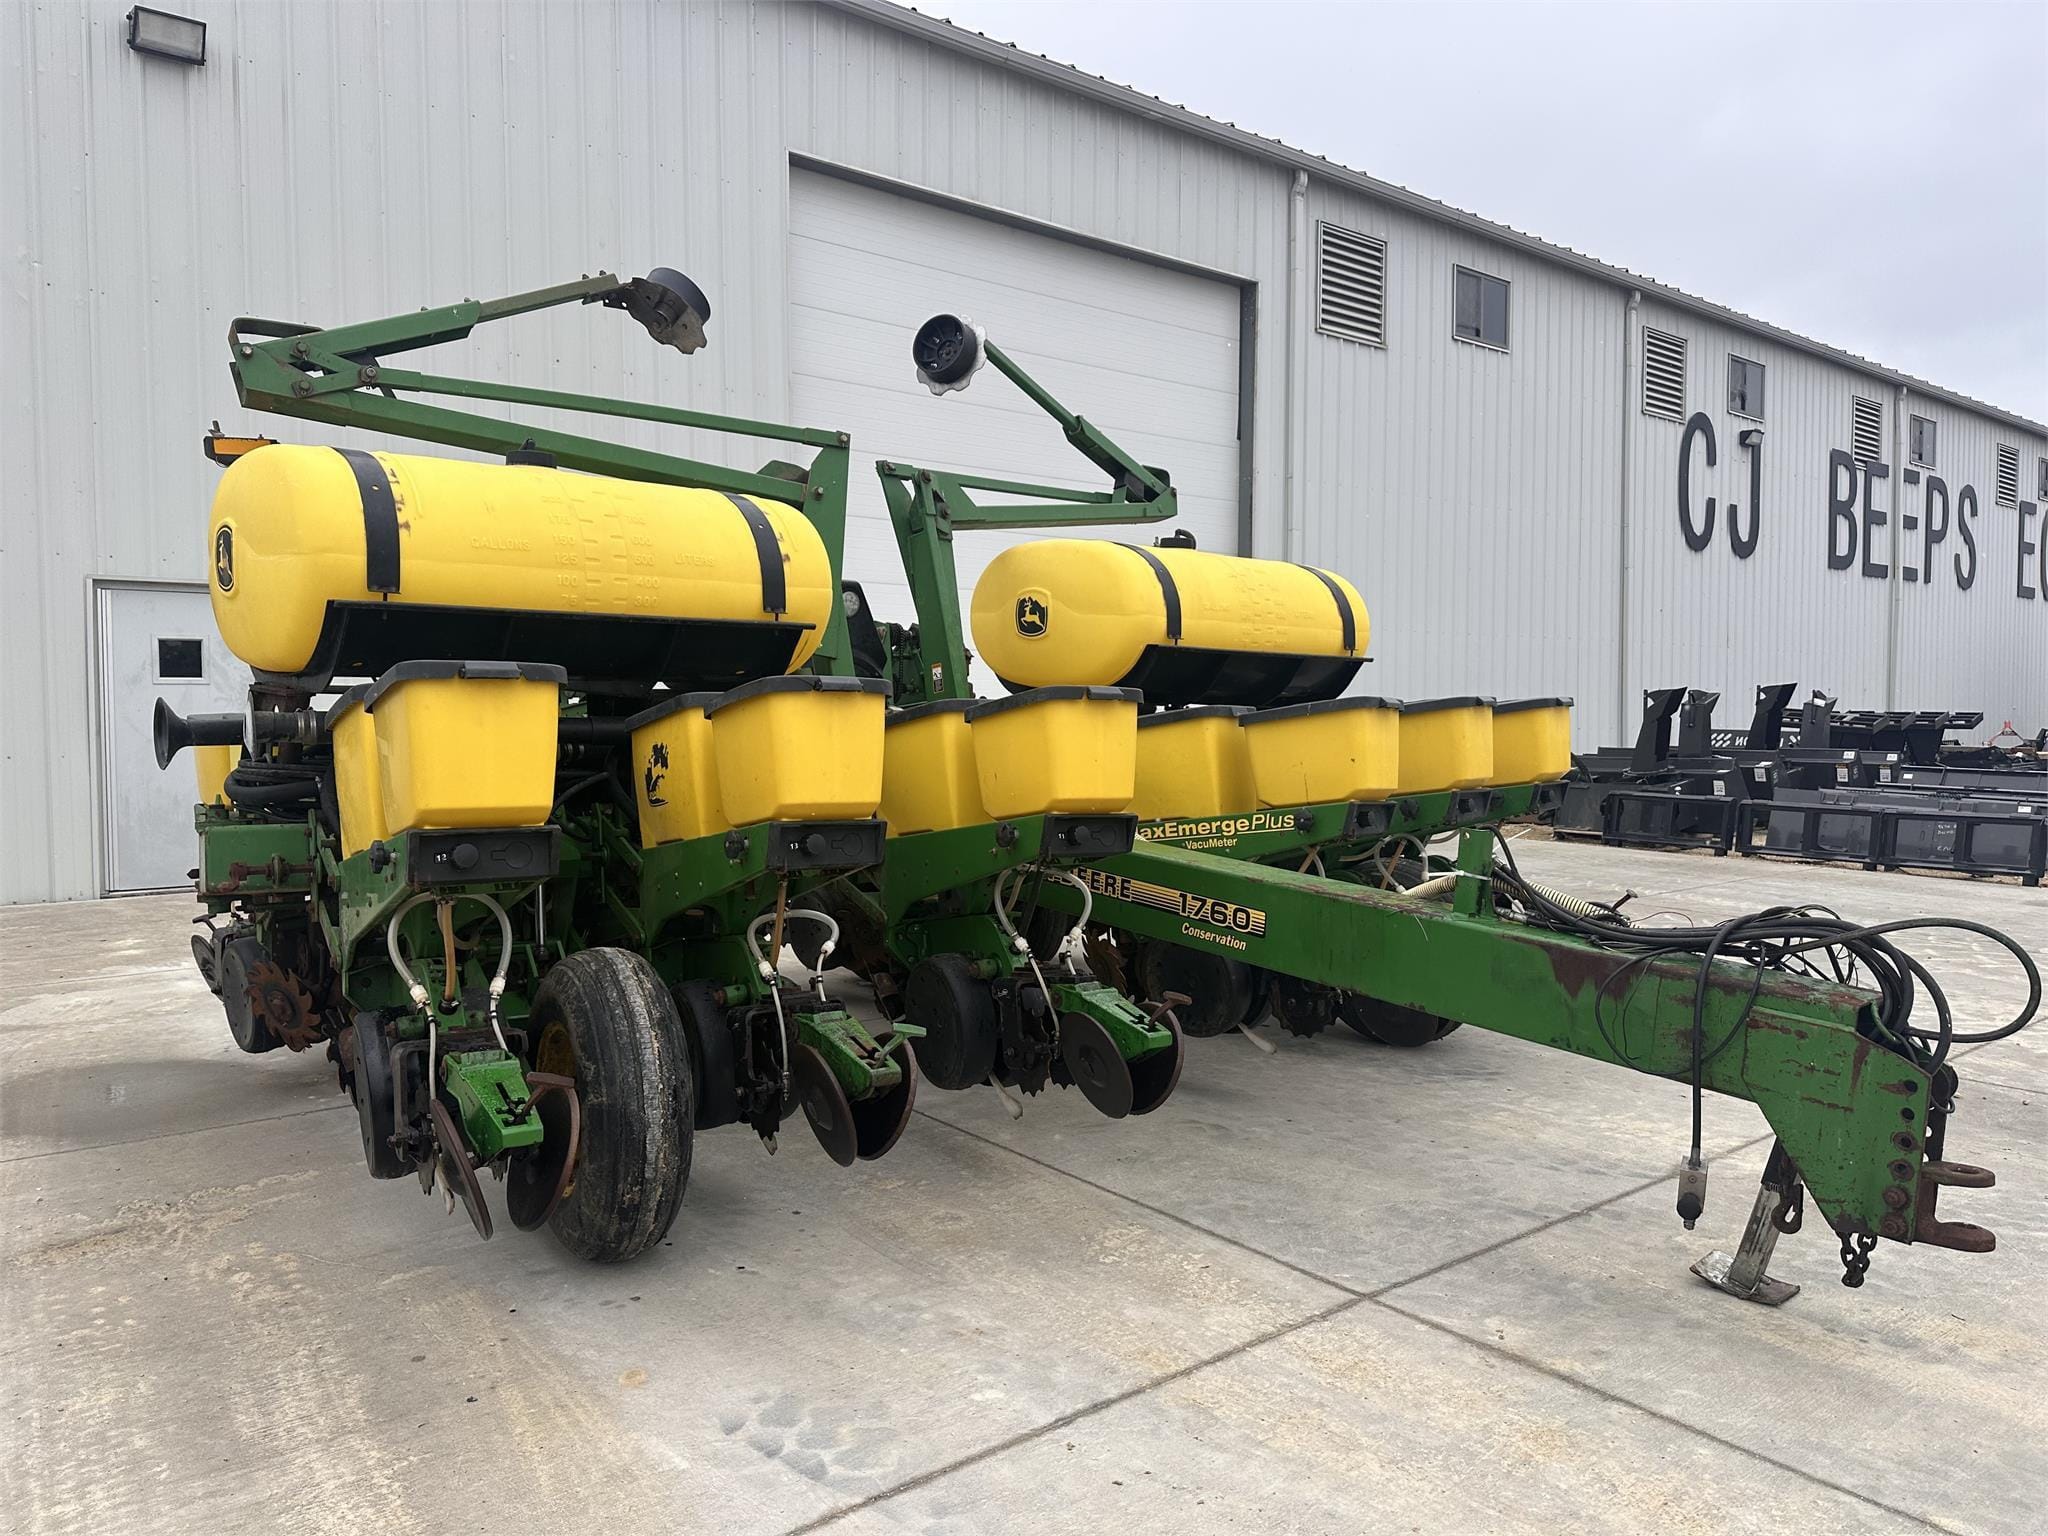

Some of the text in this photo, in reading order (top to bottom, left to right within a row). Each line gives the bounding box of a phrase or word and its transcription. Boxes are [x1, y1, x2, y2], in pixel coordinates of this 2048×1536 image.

[1678, 411, 1762, 560] CJ
[1828, 448, 1978, 590] BEEPS
[471, 535, 531, 552] GALLONS
[553, 534, 577, 546] 150
[553, 552, 578, 566] 125
[674, 552, 716, 568] LITERS
[556, 574, 578, 587] 100
[561, 594, 578, 607] 75
[634, 595, 659, 608] 300
[1136, 813, 1295, 840] axEmergePlus
[1185, 838, 1238, 850] VacuMeter
[436, 853, 447, 862] 12
[1178, 891, 1252, 933] 1760
[1181, 921, 1247, 951] Conservation
